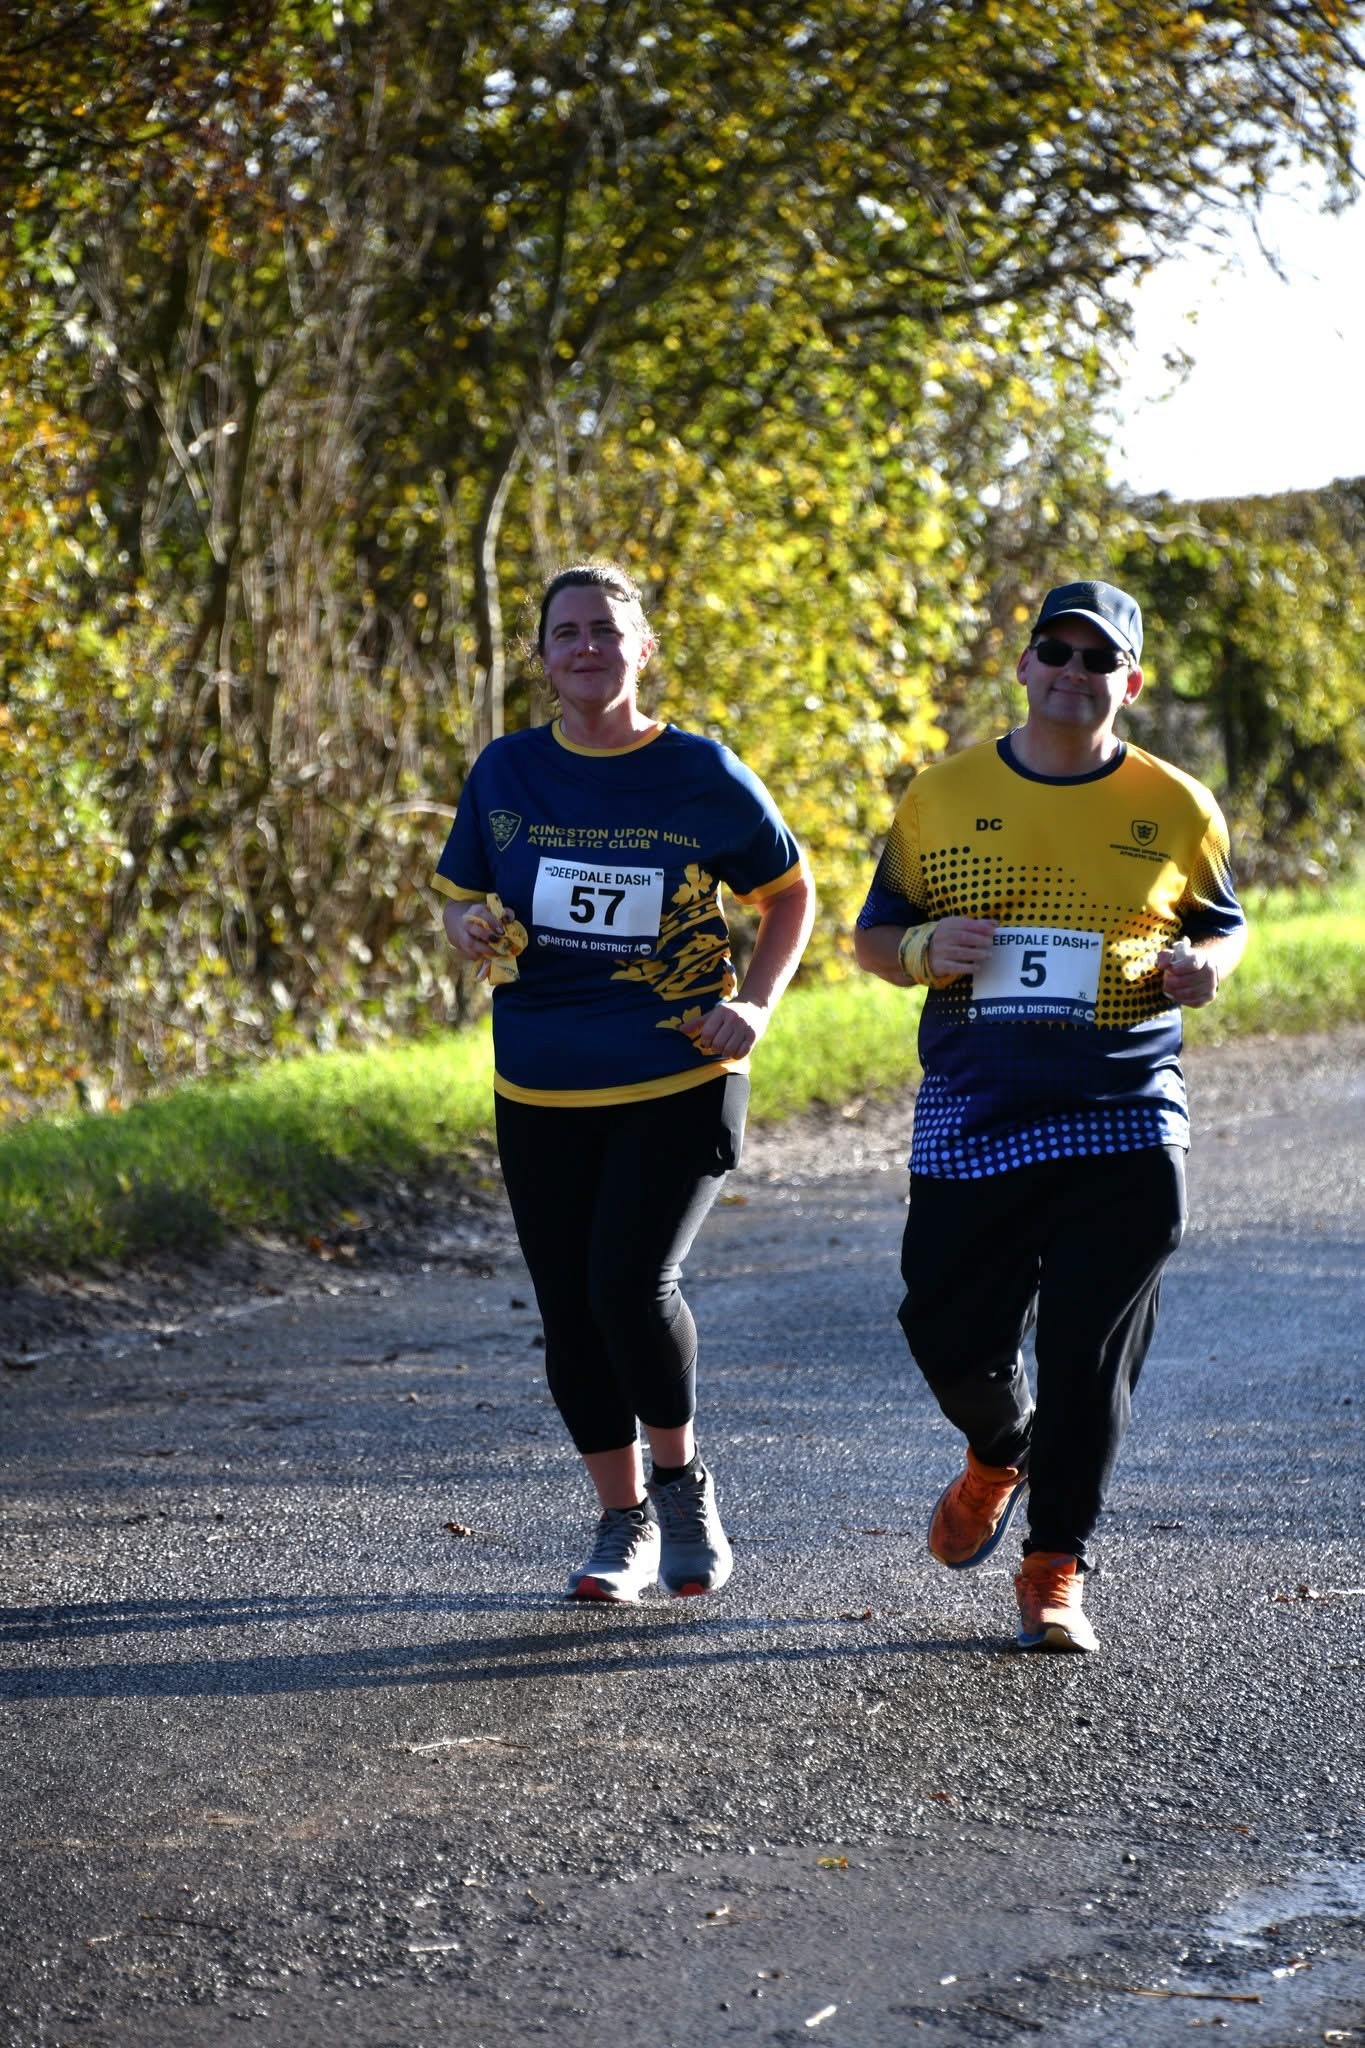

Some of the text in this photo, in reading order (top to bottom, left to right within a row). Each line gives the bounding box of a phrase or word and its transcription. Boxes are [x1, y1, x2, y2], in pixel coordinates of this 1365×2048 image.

[976, 818, 1003, 831] DC
[527, 835, 651, 849] ATHLETIC CLUB
[528, 824, 701, 848] KINGSTON UPON HULL
[550, 866, 651, 886] DEEPDALE DASH
[569, 885, 626, 926] 57
[546, 934, 579, 949] BARTON
[581, 940, 588, 949] &
[590, 941, 633, 953] DISTRICT
[992, 934, 1090, 949] EEPDALE DASH
[1020, 950, 1047, 988] 5
[1078, 991, 1088, 1000] XL
[981, 1005, 1083, 1018] BARTON & DISTRICT AC
